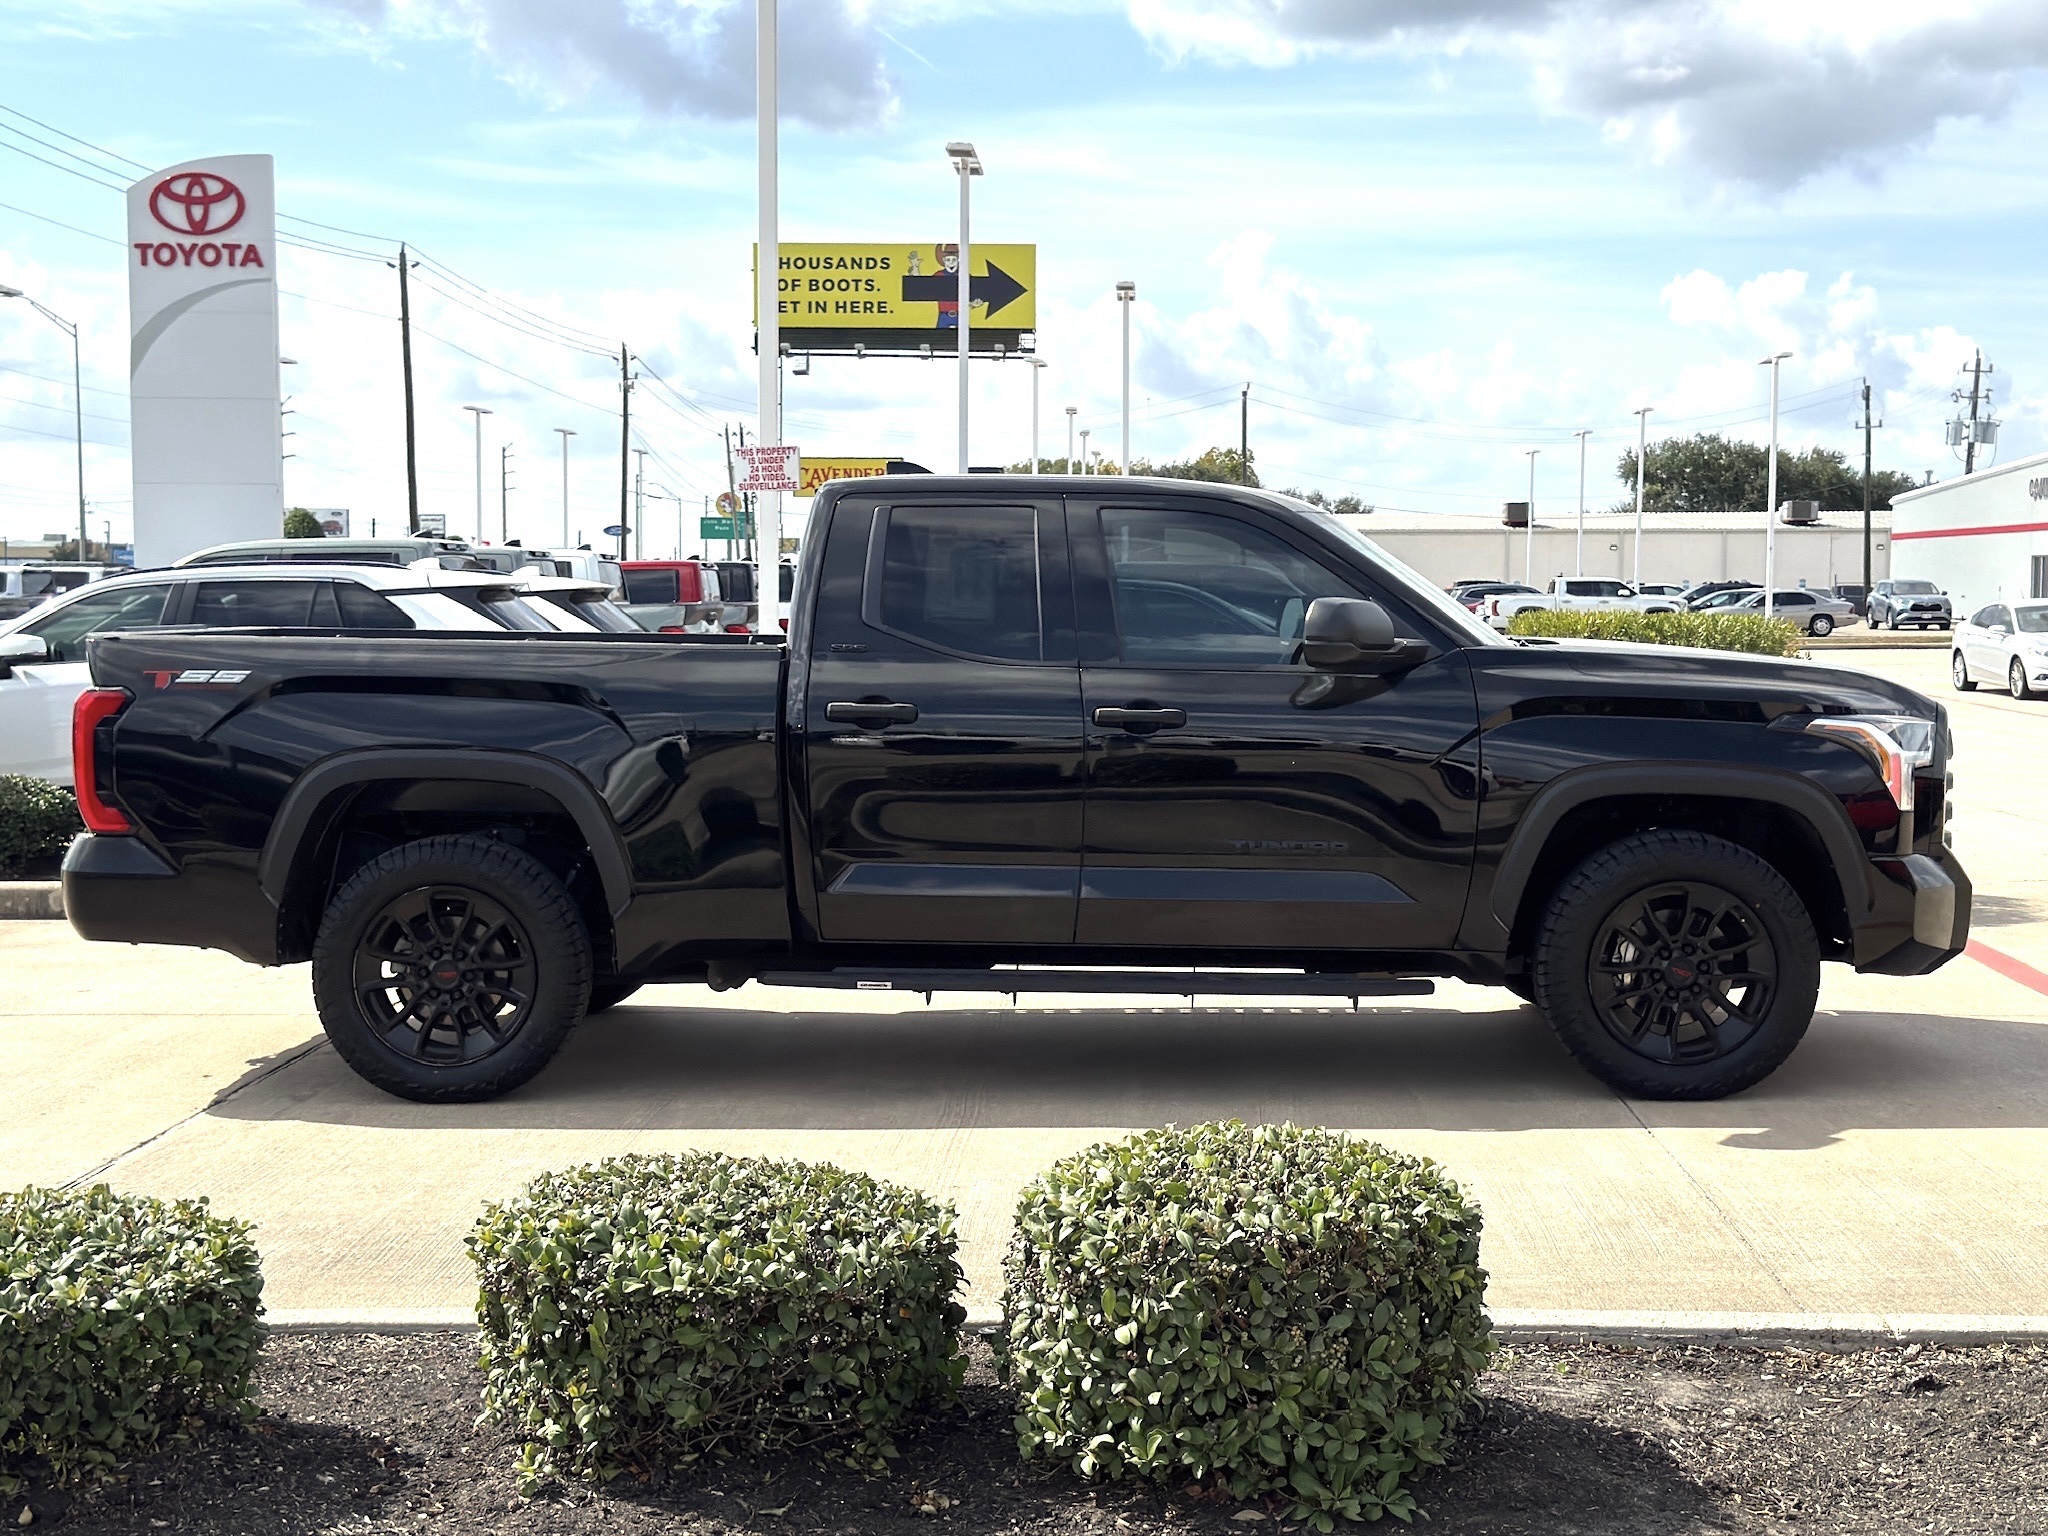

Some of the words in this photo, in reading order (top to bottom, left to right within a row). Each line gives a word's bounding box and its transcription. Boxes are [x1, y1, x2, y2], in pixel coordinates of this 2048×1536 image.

[134, 243, 264, 268] TOYOTA
[779, 257, 891, 270] HOUSANDS
[778, 279, 801, 292] OF
[808, 279, 881, 292] BOOTS.
[778, 301, 800, 314] ET
[808, 301, 827, 314] IN
[835, 301, 894, 314] HERE.
[736, 449, 754, 457] THIS
[756, 446, 798, 456] PROPERTY
[748, 457, 756, 465] IS
[758, 456, 785, 465] UNDER
[750, 465, 760, 473] 24
[762, 464, 784, 473] HOUR
[749, 474, 760, 482] HD
[762, 473, 786, 481] VIDEO
[739, 481, 798, 491] SURVEILLANCE
